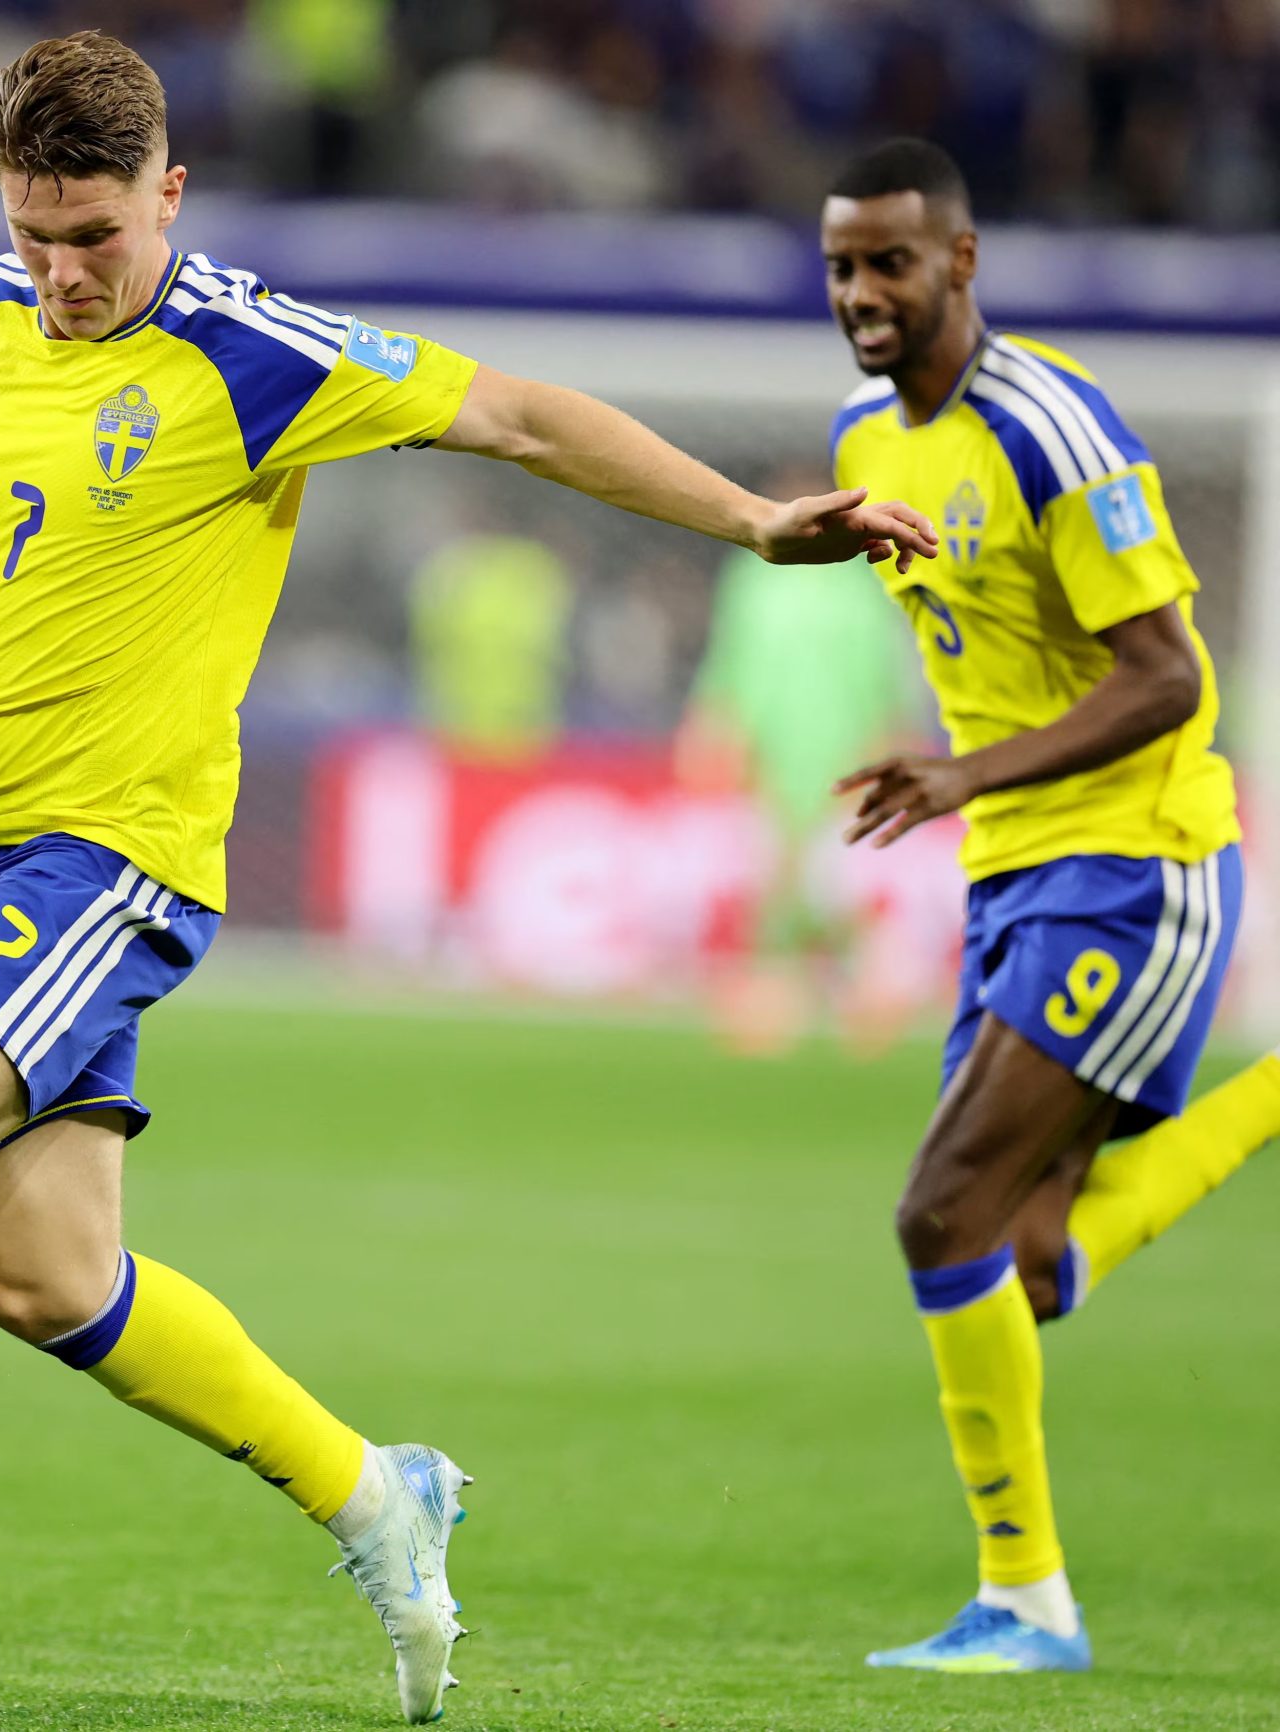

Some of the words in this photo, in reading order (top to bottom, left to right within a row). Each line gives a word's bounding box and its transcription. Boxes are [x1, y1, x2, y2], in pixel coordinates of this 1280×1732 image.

[107, 410, 149, 422] SVERIGE
[111, 490, 133, 500] SWEDEN
[1044, 947, 1121, 1037] 9
